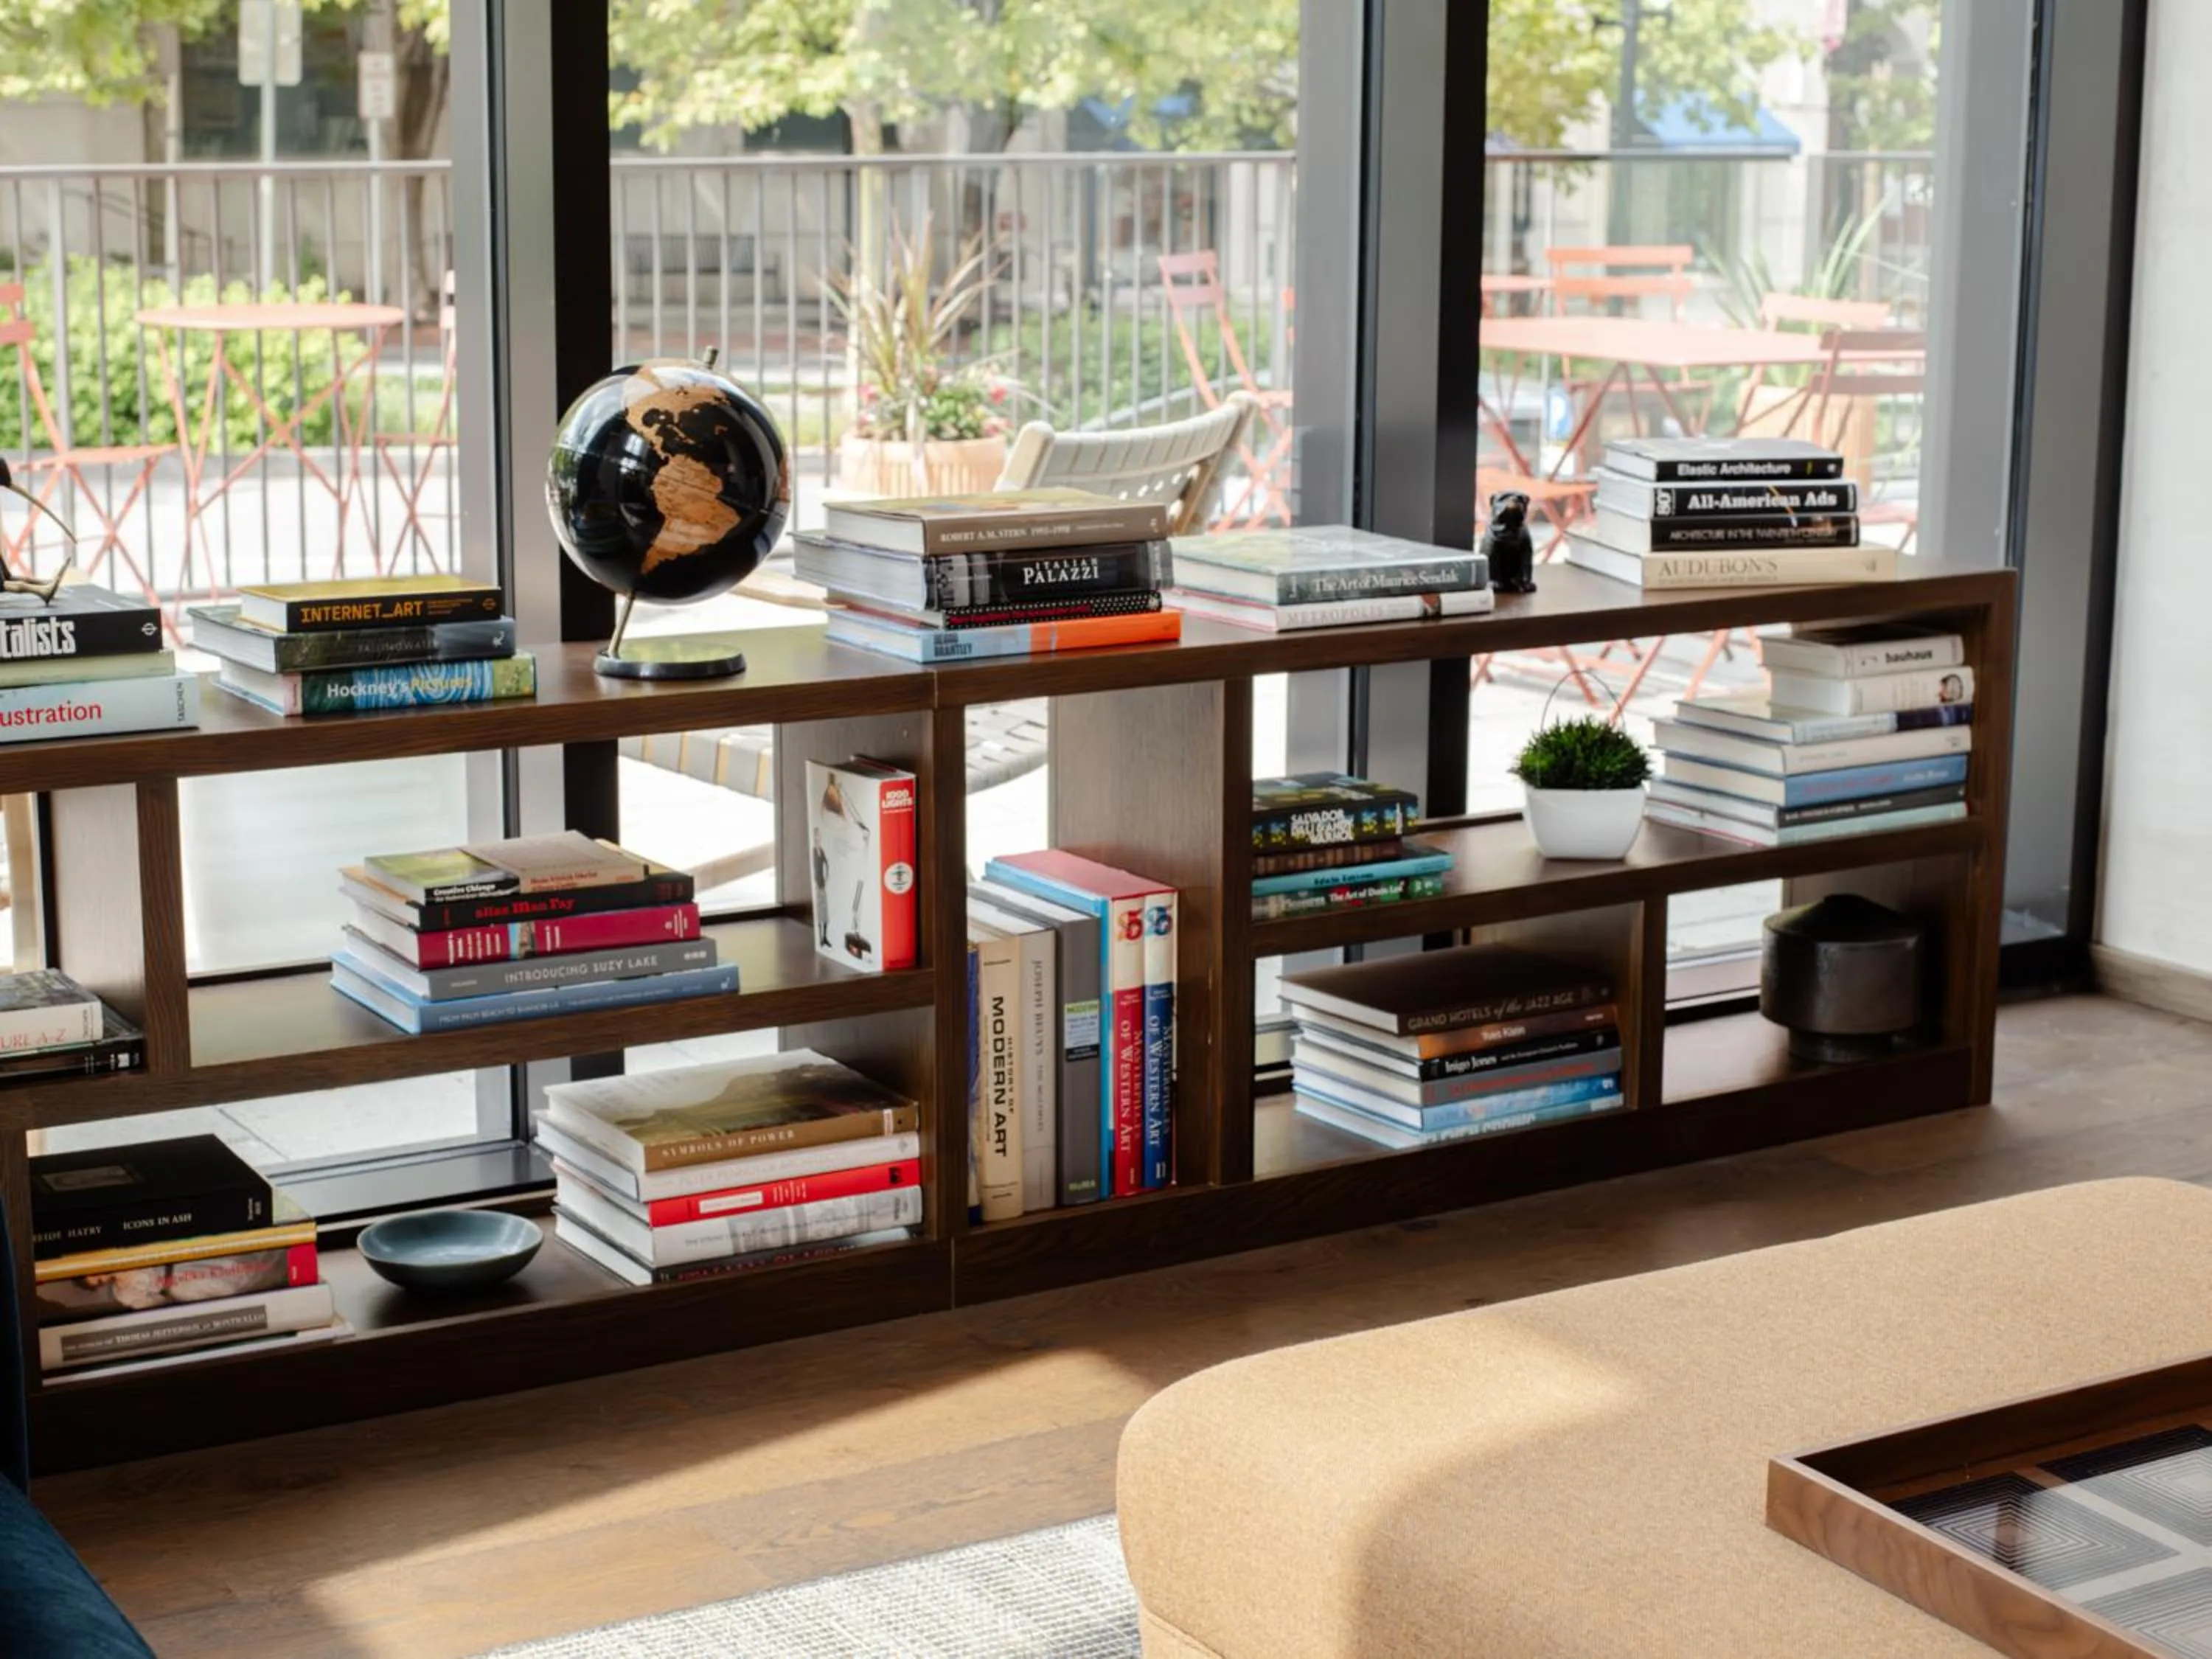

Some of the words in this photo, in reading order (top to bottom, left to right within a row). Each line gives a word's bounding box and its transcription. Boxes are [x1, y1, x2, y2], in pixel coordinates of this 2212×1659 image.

[1677, 464, 1717, 476] Elastic
[1719, 462, 1792, 475] Architecture
[1687, 493, 1801, 509] All-American
[1805, 491, 1837, 507] Ads
[1023, 566, 1099, 585] PALAZZI
[1034, 557, 1099, 570] ITALIAN
[1314, 578, 1337, 592] The
[1338, 577, 1354, 591] Art
[1355, 575, 1369, 588] of
[1371, 573, 1417, 588] Maurice
[1418, 568, 1459, 585] Sendak
[300, 600, 424, 623] INTERNET_ART
[327, 679, 408, 699] Hockney's
[0, 699, 102, 726] ustration
[504, 961, 588, 984] INTRODUCING
[592, 959, 623, 974] SUZY
[627, 956, 658, 970] LAKE
[1032, 959, 1044, 1008] JOSEPH
[1407, 1012, 1447, 1030] GRAND
[1449, 1006, 1491, 1023] HOTELS
[1553, 991, 1574, 1005] AGE
[1120, 1020, 1131, 1038] OF
[1150, 1015, 1160, 1034] OF
[992, 996, 1006, 1105] MODERN
[1120, 1045, 1133, 1118] WESTERN
[1150, 1040, 1163, 1113] WESTERN
[661, 1141, 722, 1157] SYMBOLS
[728, 1138, 744, 1148] OF
[750, 1130, 795, 1145] POWER
[994, 1111, 1007, 1158] ART
[1120, 1123, 1133, 1153] ART
[1150, 1118, 1163, 1146] ART
[67, 1225, 102, 1239] HATRY
[122, 1219, 154, 1231] ICONS
[158, 1217, 170, 1226] IN
[172, 1213, 192, 1224] ASH
[115, 1332, 150, 1343] THOMAS
[152, 1322, 202, 1338] JEFFERSON
